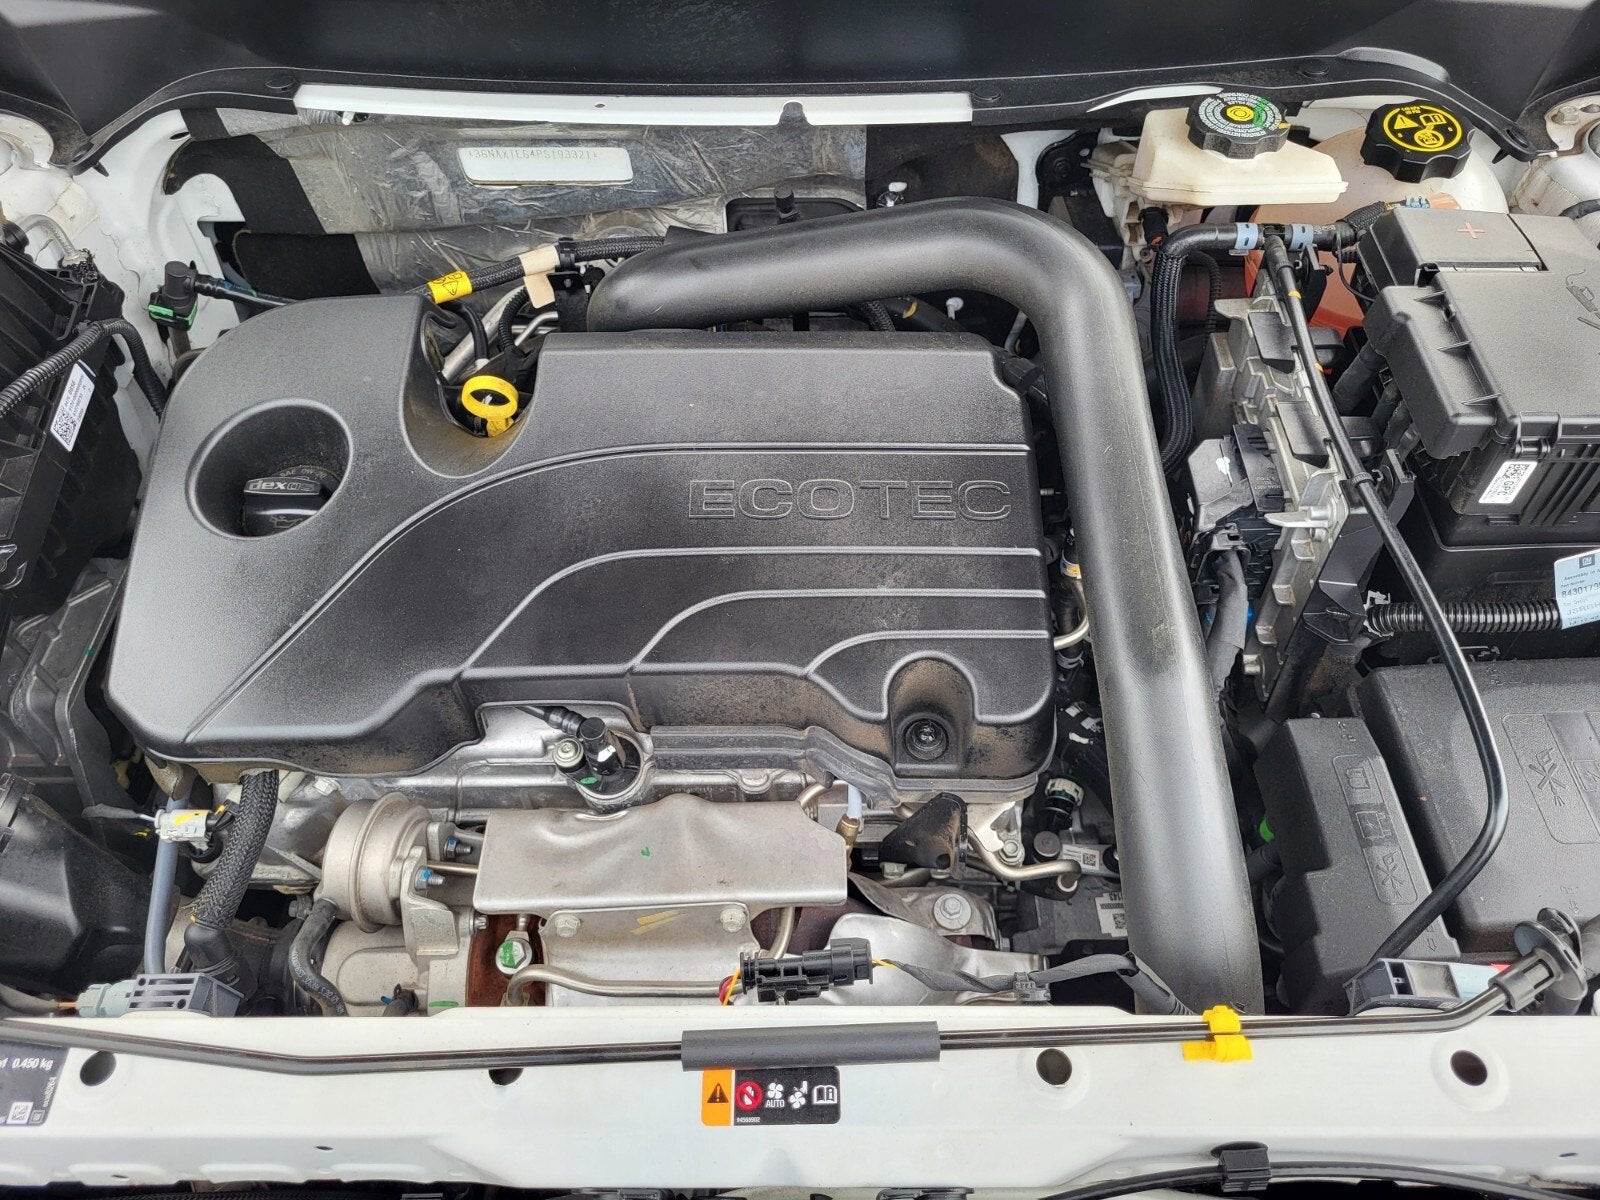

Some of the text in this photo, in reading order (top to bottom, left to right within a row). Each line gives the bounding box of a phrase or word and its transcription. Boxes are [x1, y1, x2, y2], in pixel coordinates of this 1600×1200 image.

[248, 480, 315, 492] dexos
[688, 478, 1012, 520] ECOTEC
[40, 1057, 54, 1071] kg
[765, 1099, 785, 1108] AUTO
